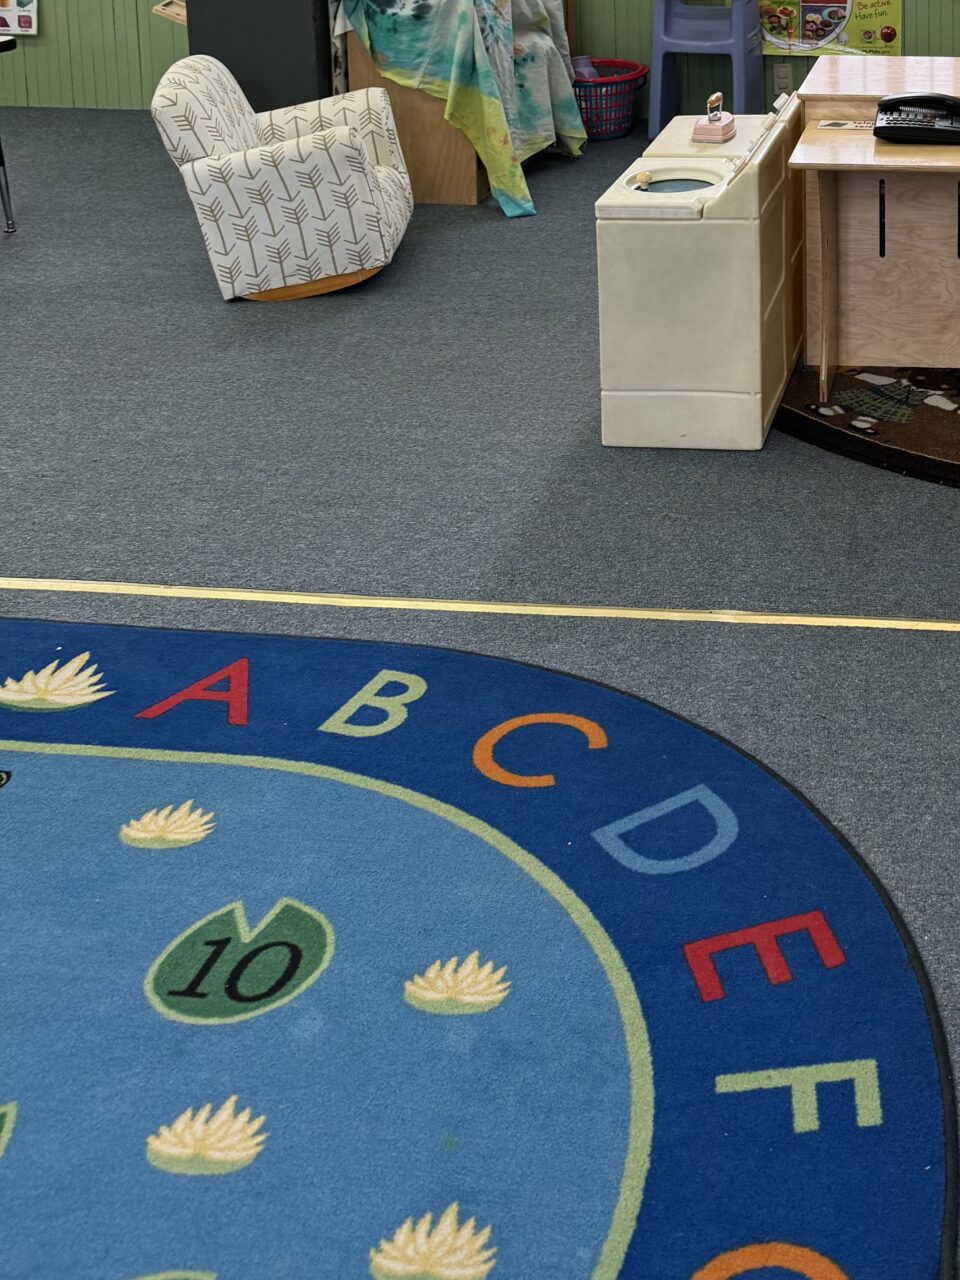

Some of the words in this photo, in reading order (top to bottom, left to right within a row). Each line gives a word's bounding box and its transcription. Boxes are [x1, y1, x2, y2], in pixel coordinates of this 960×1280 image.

[855, 11, 873, 20] Have
[857, 2, 869, 11] Be
[135, 658, 250, 726] A
[319, 669, 428, 738] B
[472, 712, 608, 788] C
[590, 784, 740, 875] D
[168, 935, 303, 1004] 10
[683, 910, 847, 1002] E
[715, 1059, 883, 1134] F
